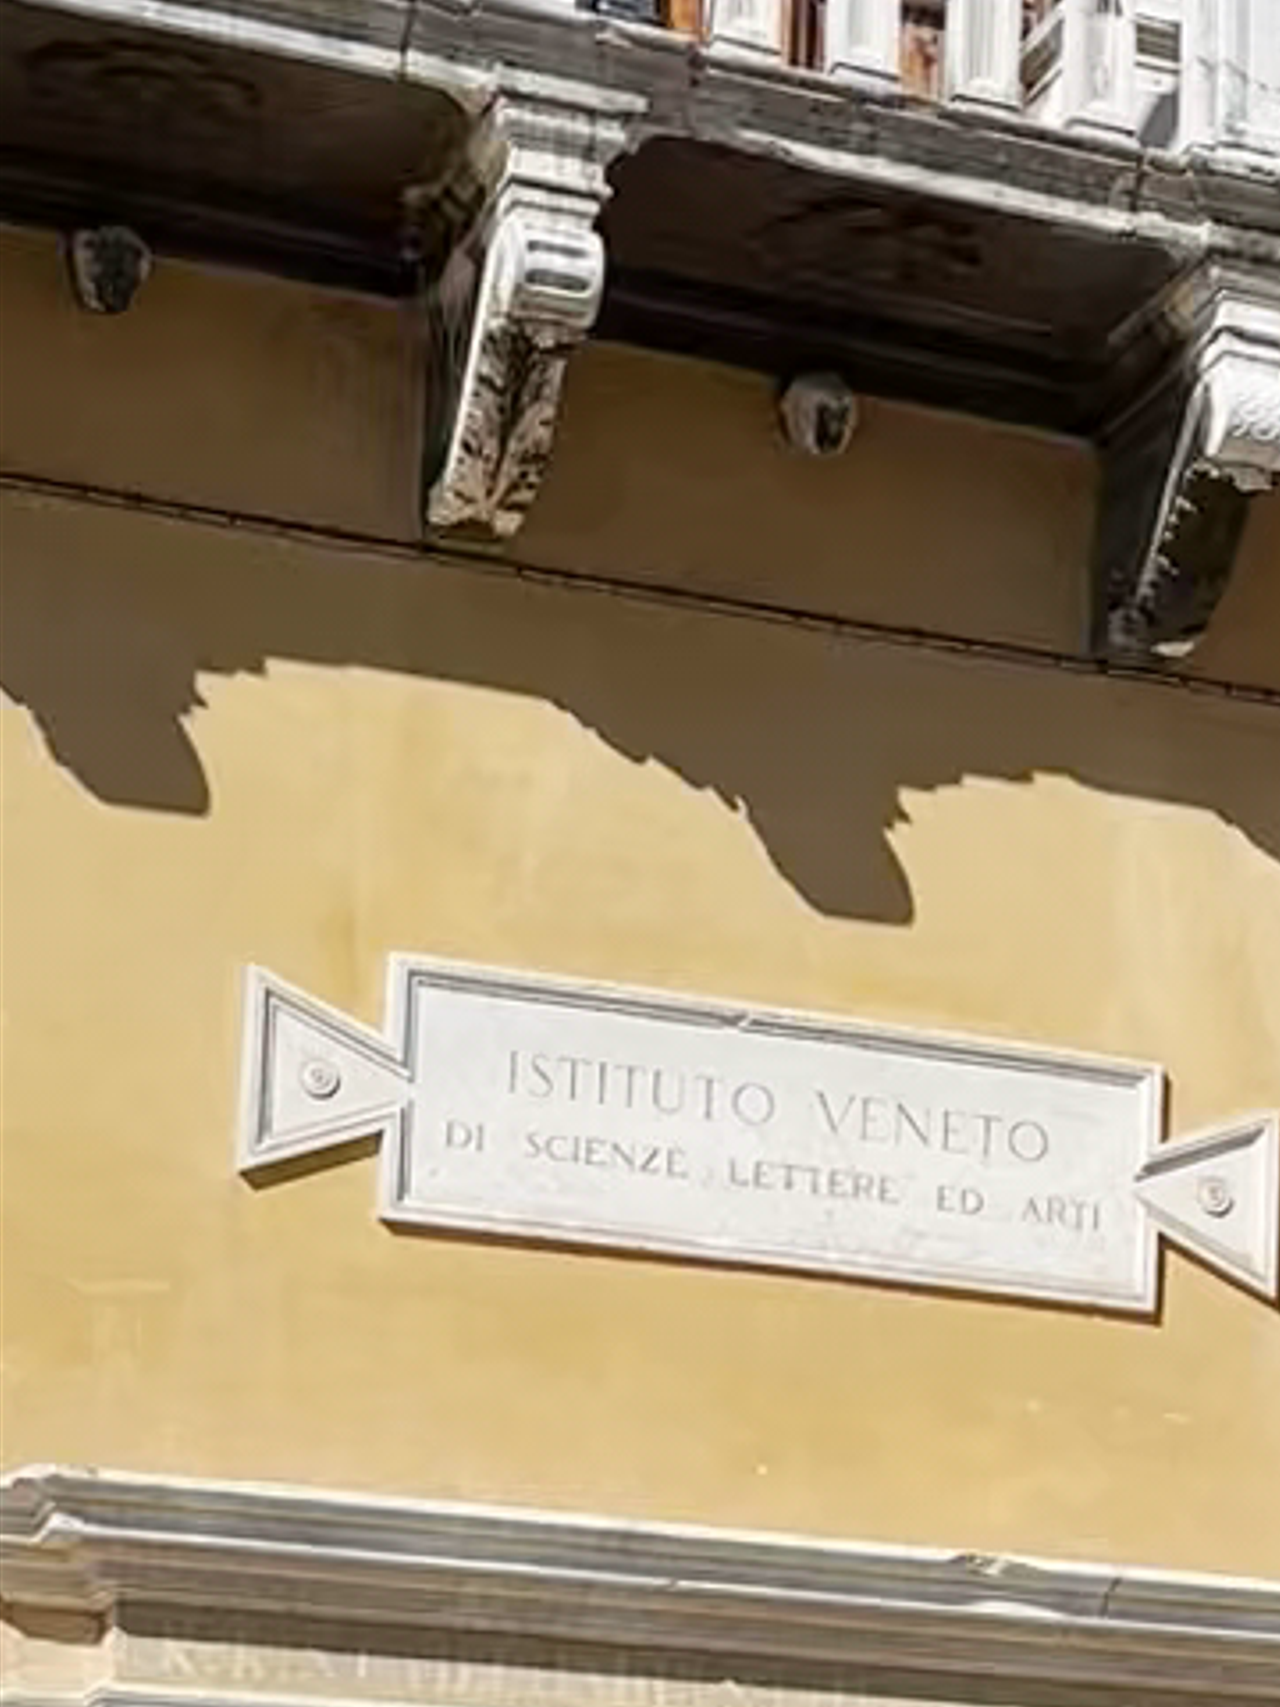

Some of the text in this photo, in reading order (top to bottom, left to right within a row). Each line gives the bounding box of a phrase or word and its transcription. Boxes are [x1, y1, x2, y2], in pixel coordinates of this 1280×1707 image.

[509, 1049, 1049, 1163] ISTITUTO VENETO
[446, 1120, 1099, 1231] DI SCIENZE LETTERE ED ARTI
